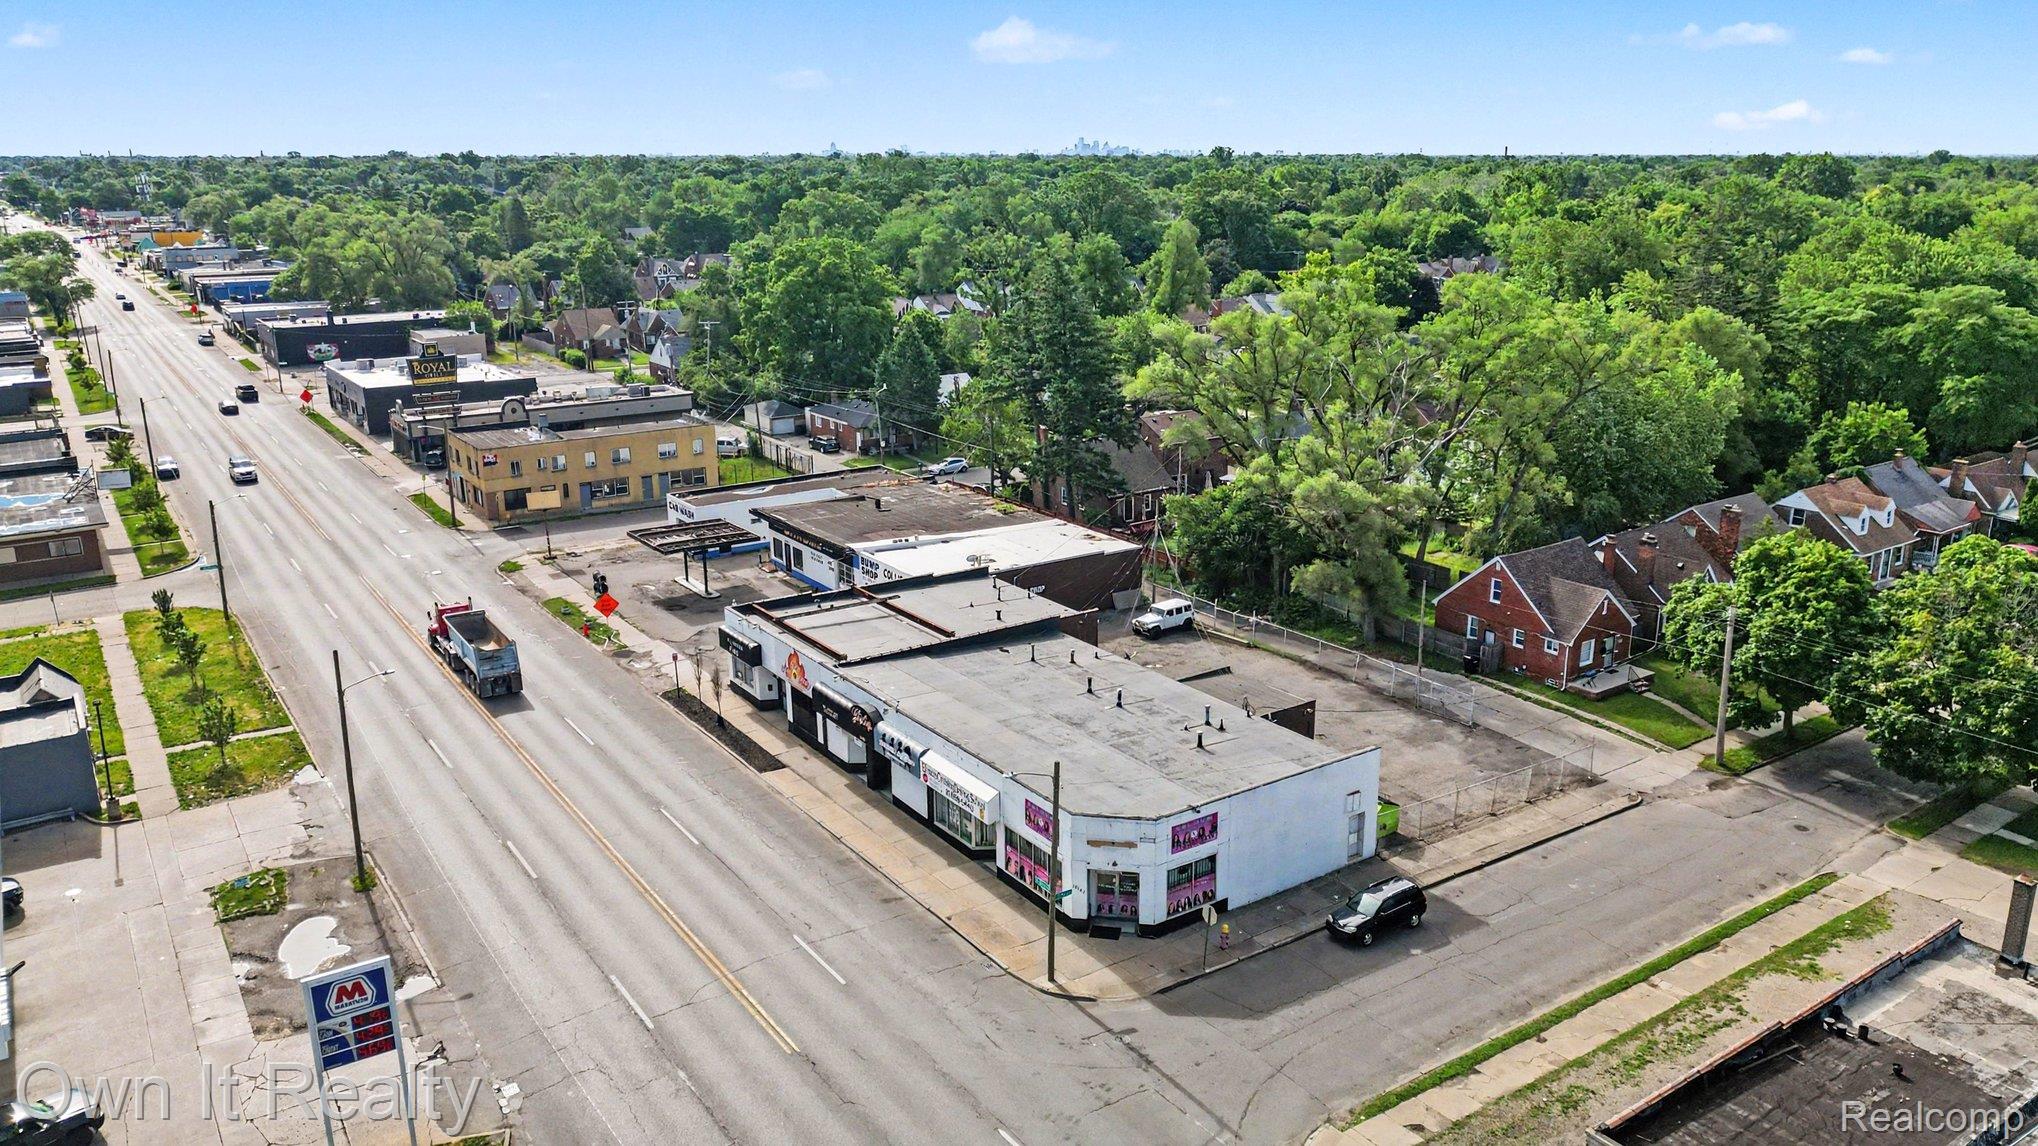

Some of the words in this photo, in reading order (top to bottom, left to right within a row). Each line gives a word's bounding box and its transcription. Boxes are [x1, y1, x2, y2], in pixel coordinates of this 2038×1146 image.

[411, 361, 455, 375] ROYAL
[680, 506, 695, 520] WASH
[860, 556, 880, 571] BUMP
[861, 566, 878, 580] SHOP
